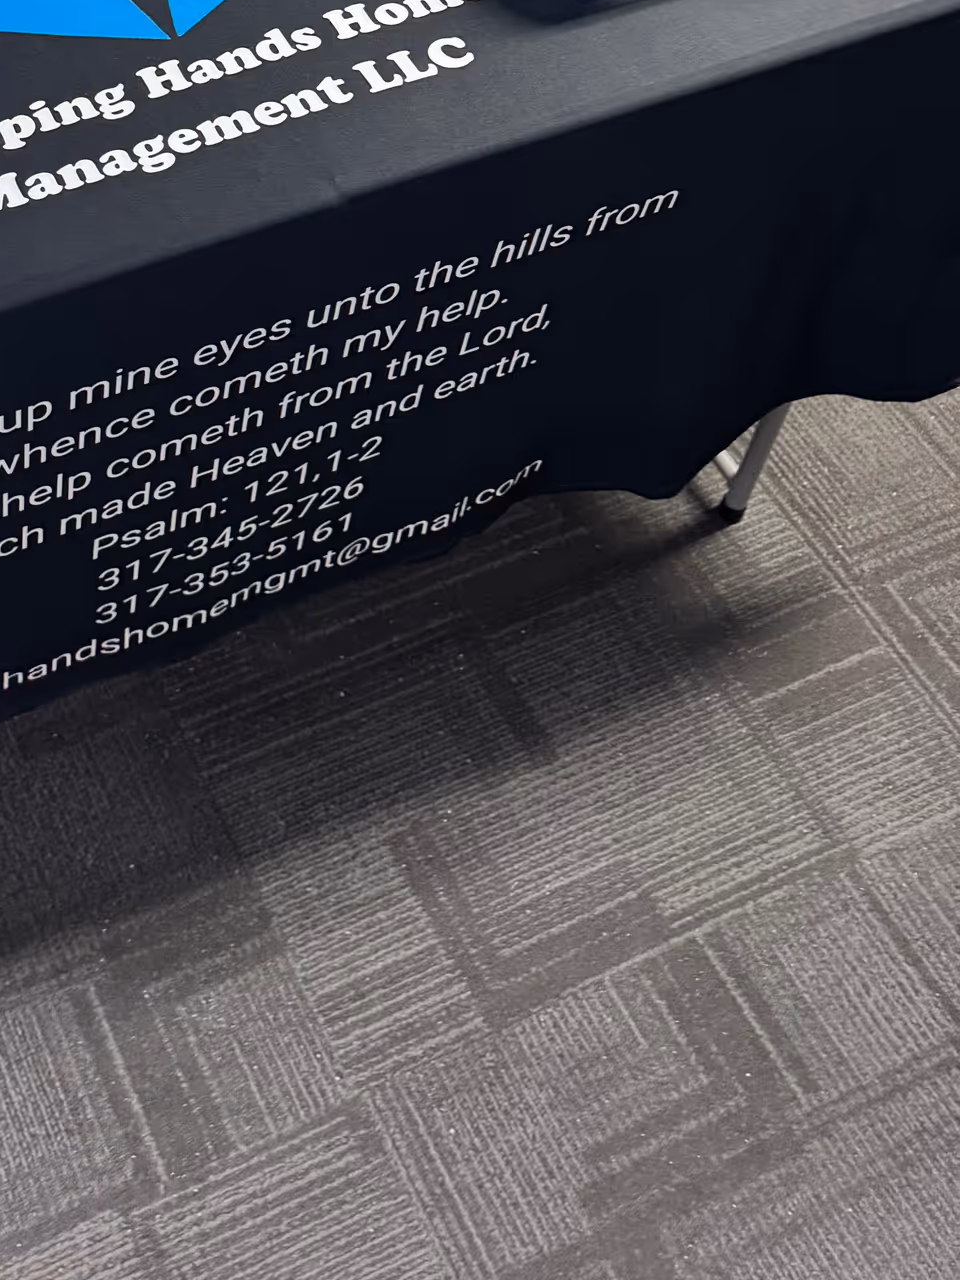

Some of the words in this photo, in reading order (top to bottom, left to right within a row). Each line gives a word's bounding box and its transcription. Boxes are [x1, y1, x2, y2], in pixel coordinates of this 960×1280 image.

[136, 27, 322, 99] Hands
[352, 37, 475, 93] LLC
[0, 401, 53, 433] up
[70, 358, 179, 410] mine
[194, 319, 292, 366] eyes
[307, 283, 400, 328] unto
[415, 257, 479, 292] the
[491, 224, 573, 268] hills
[586, 190, 679, 236] from
[170, 344, 329, 416] cometh
[343, 320, 407, 358] my
[416, 290, 508, 333] help.
[3, 472, 92, 517] help
[107, 407, 264, 478] cometh
[280, 372, 373, 419] from
[387, 347, 447, 380] the
[459, 304, 550, 356] Lord,
[61, 481, 177, 535] made
[191, 422, 338, 489] Heaven
[352, 384, 424, 429] and
[435, 350, 537, 399] earth.
[93, 497, 228, 560] Psalm:
[245, 436, 383, 502] 121,1-2
[98, 476, 364, 591] 317-345-2726
[96, 513, 352, 624] 317-353-5161
